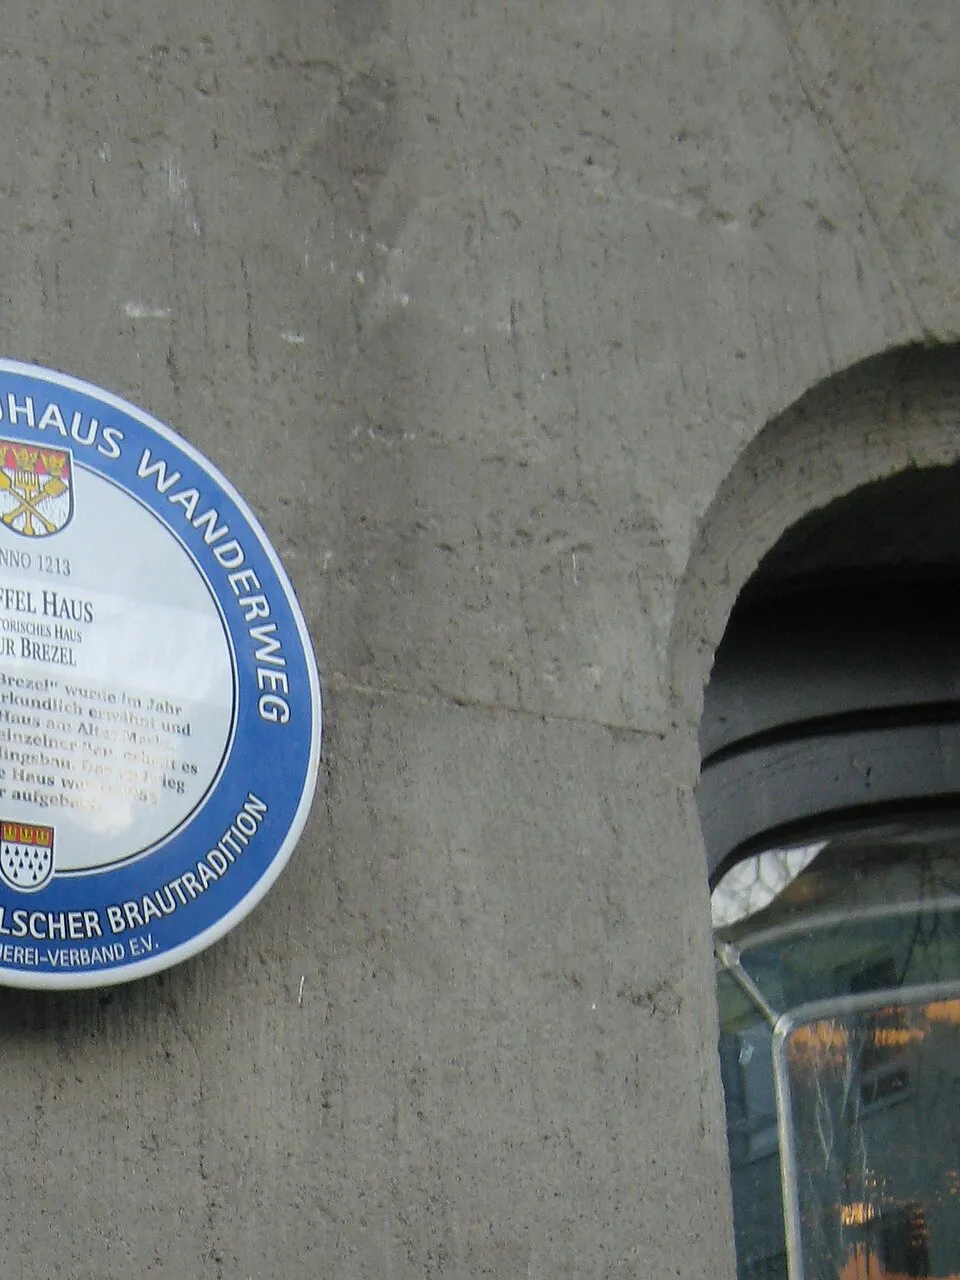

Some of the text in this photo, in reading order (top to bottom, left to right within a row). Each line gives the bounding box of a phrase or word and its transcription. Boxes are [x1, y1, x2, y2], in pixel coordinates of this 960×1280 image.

[37, 553, 71, 577] 1213
[136, 447, 292, 726] WANDERWEG
[41, 589, 94, 624] HAUS
[54, 623, 83, 644] HAUS
[20, 636, 78, 668] BREZEL
[161, 719, 192, 738] und
[12, 766, 56, 787] Haus
[181, 760, 199, 775] es
[107, 791, 269, 935] BRAUTRADITION
[130, 932, 161, 957] E.V.
